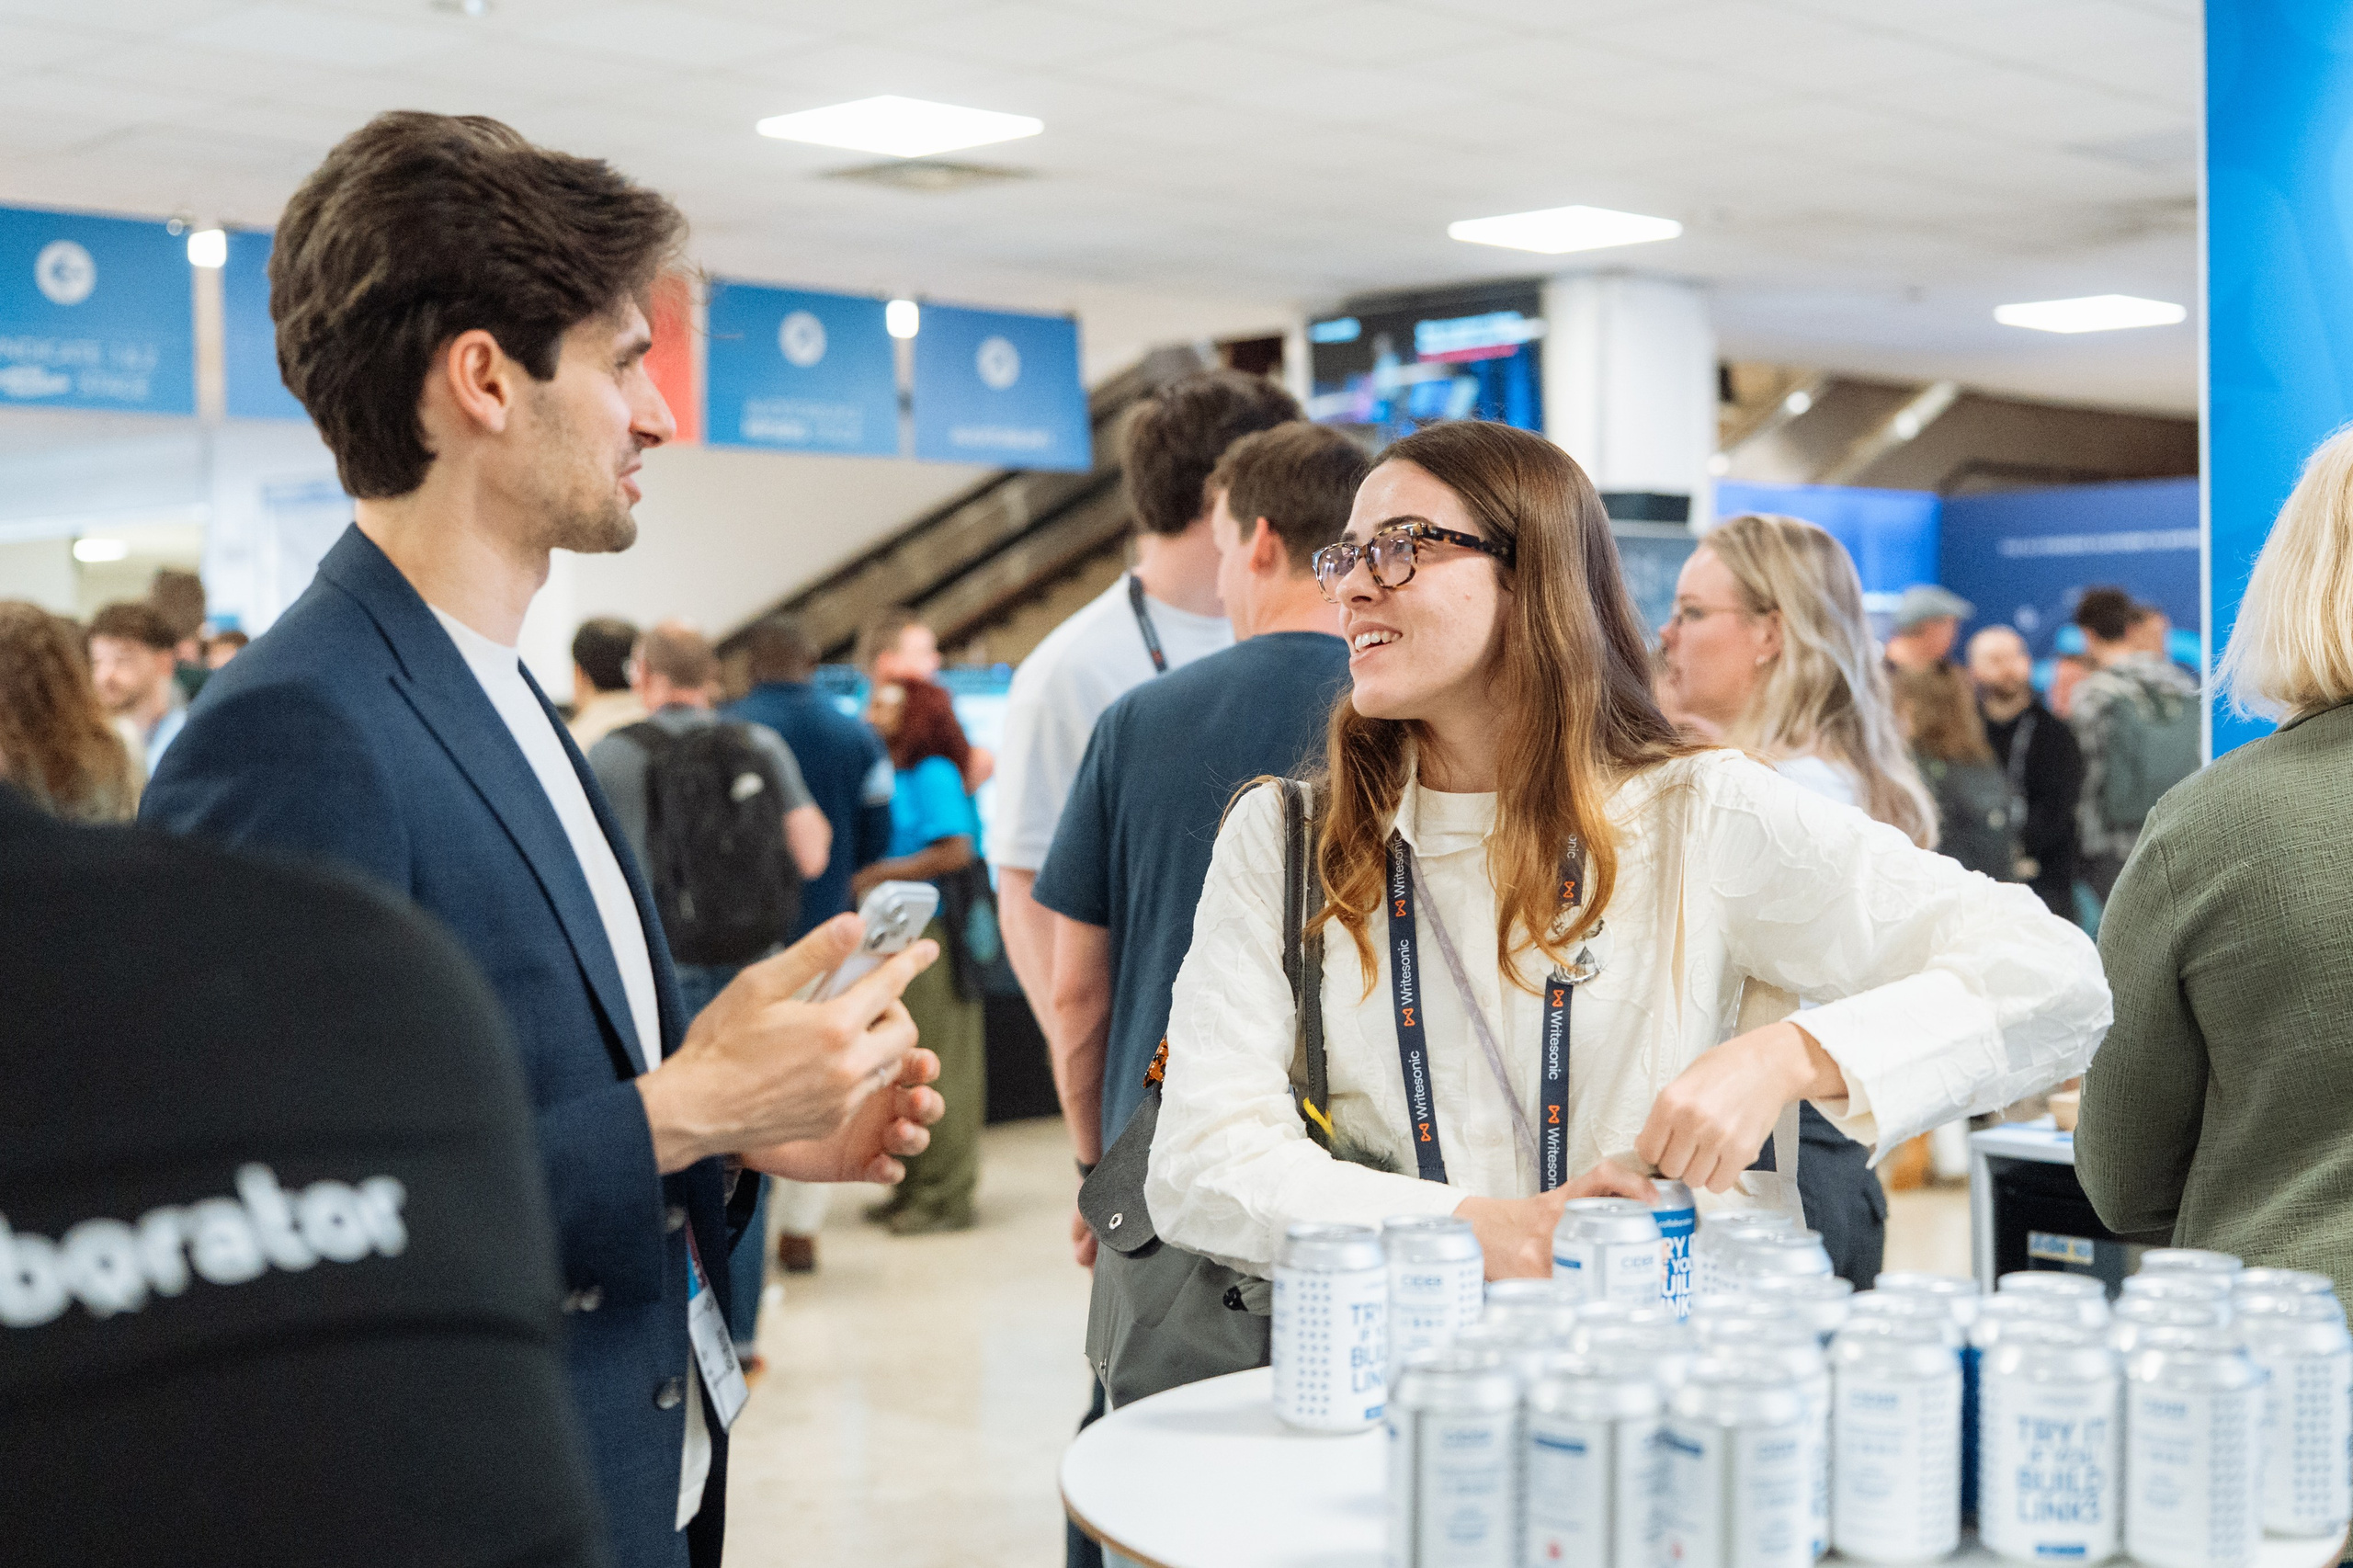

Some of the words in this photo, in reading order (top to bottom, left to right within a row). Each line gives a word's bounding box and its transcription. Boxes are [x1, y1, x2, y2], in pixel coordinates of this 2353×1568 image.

[1393, 834, 1405, 899] Writesonic
[1397, 938, 1414, 1006] Writesonic
[1548, 1010, 1563, 1081] Writesonic
[1408, 1050, 1428, 1121] Writesonic
[1547, 1127, 1560, 1190] Writesoni
